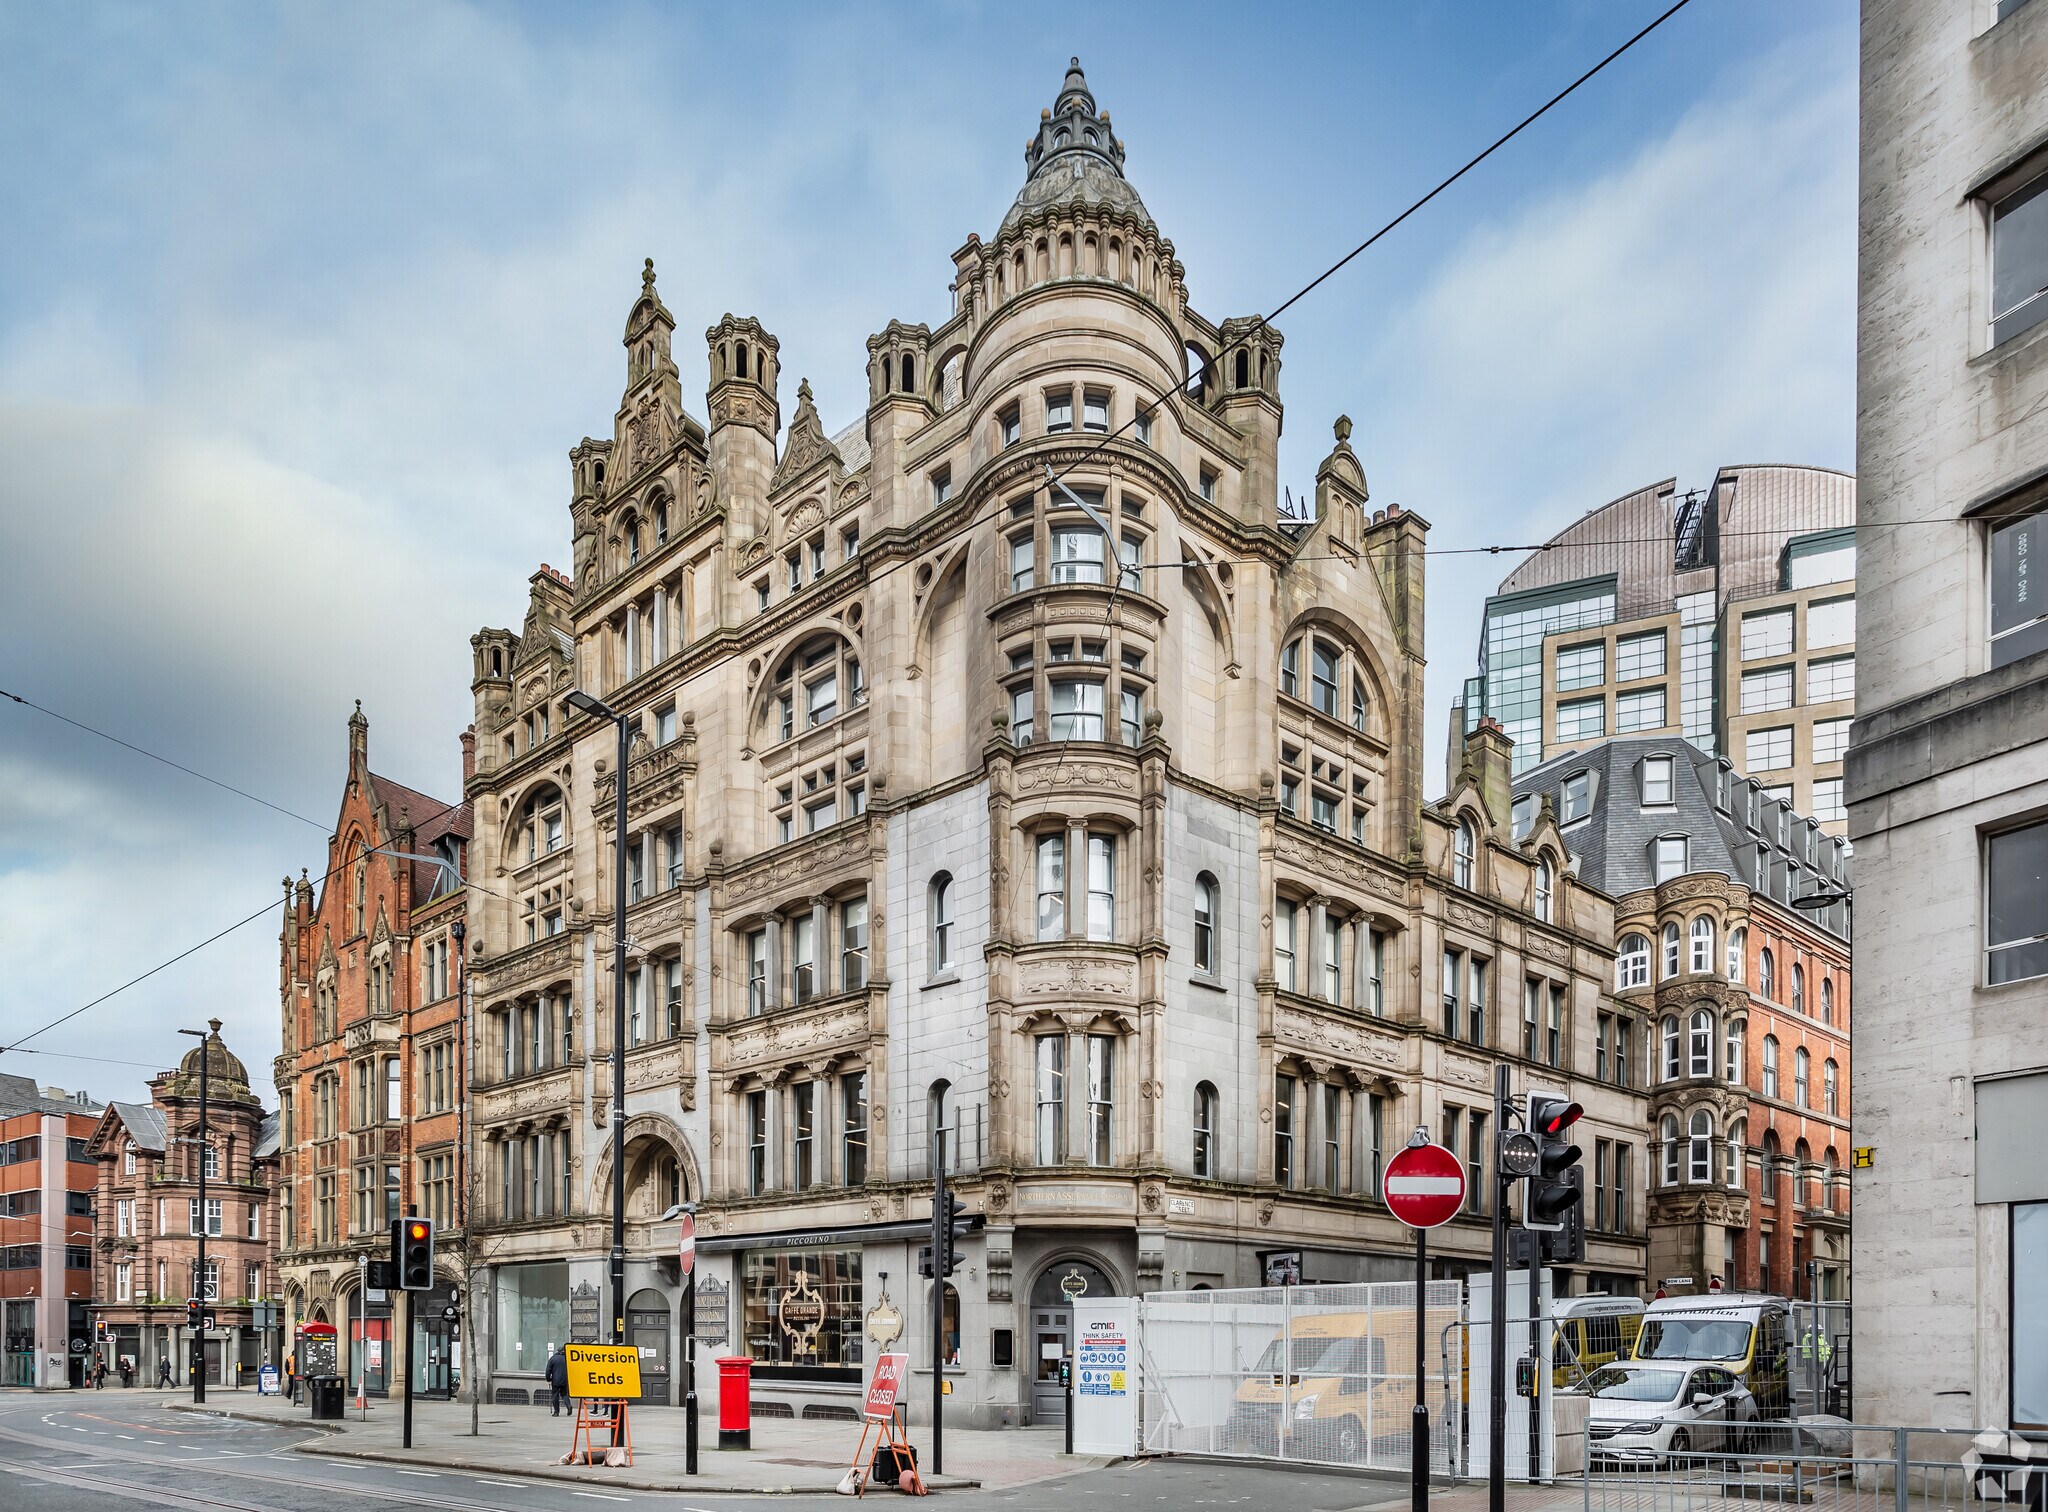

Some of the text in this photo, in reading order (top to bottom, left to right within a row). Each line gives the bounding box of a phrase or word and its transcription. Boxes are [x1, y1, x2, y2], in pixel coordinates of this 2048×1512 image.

[1856, 1148, 1871, 1166] H
[1170, 1199, 1194, 1208] CLARENCE
[786, 1235, 829, 1246] PICCOLINO
[800, 1306, 818, 1314] GRANDE
[570, 1350, 636, 1364] Diversion
[588, 1372, 623, 1385] Ends
[878, 1365, 897, 1380] ROAD
[869, 1388, 894, 1405] CLOSED
